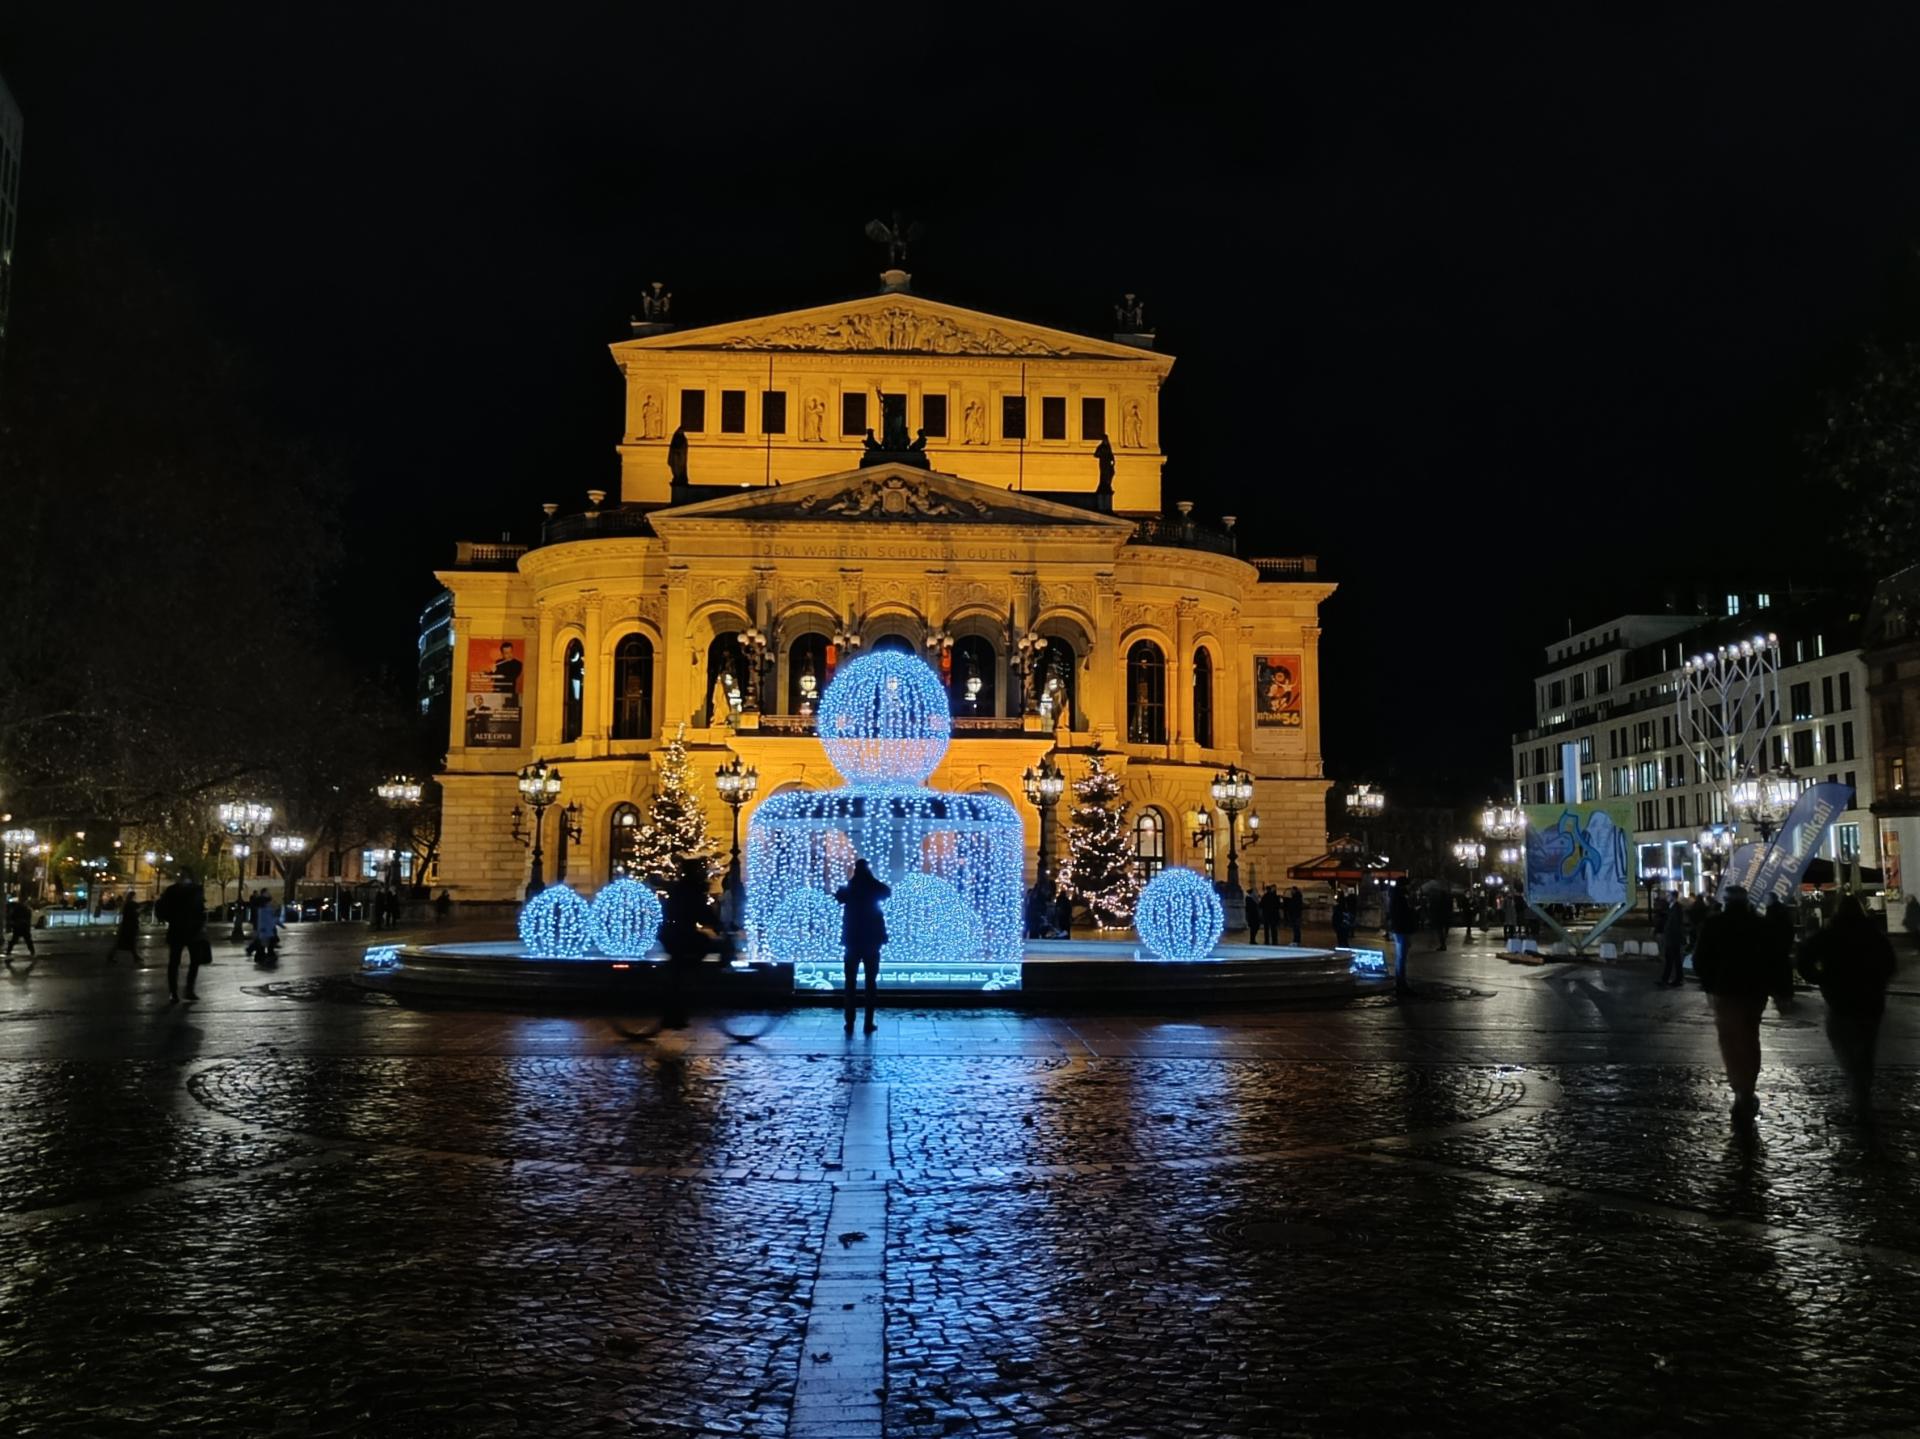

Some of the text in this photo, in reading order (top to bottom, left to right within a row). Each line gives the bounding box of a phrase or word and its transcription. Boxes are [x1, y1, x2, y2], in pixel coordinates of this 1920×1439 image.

[763, 543, 1018, 561] DEM WAHREN SCHOENEN GUTEN
[1280, 712, 1300, 725] 56
